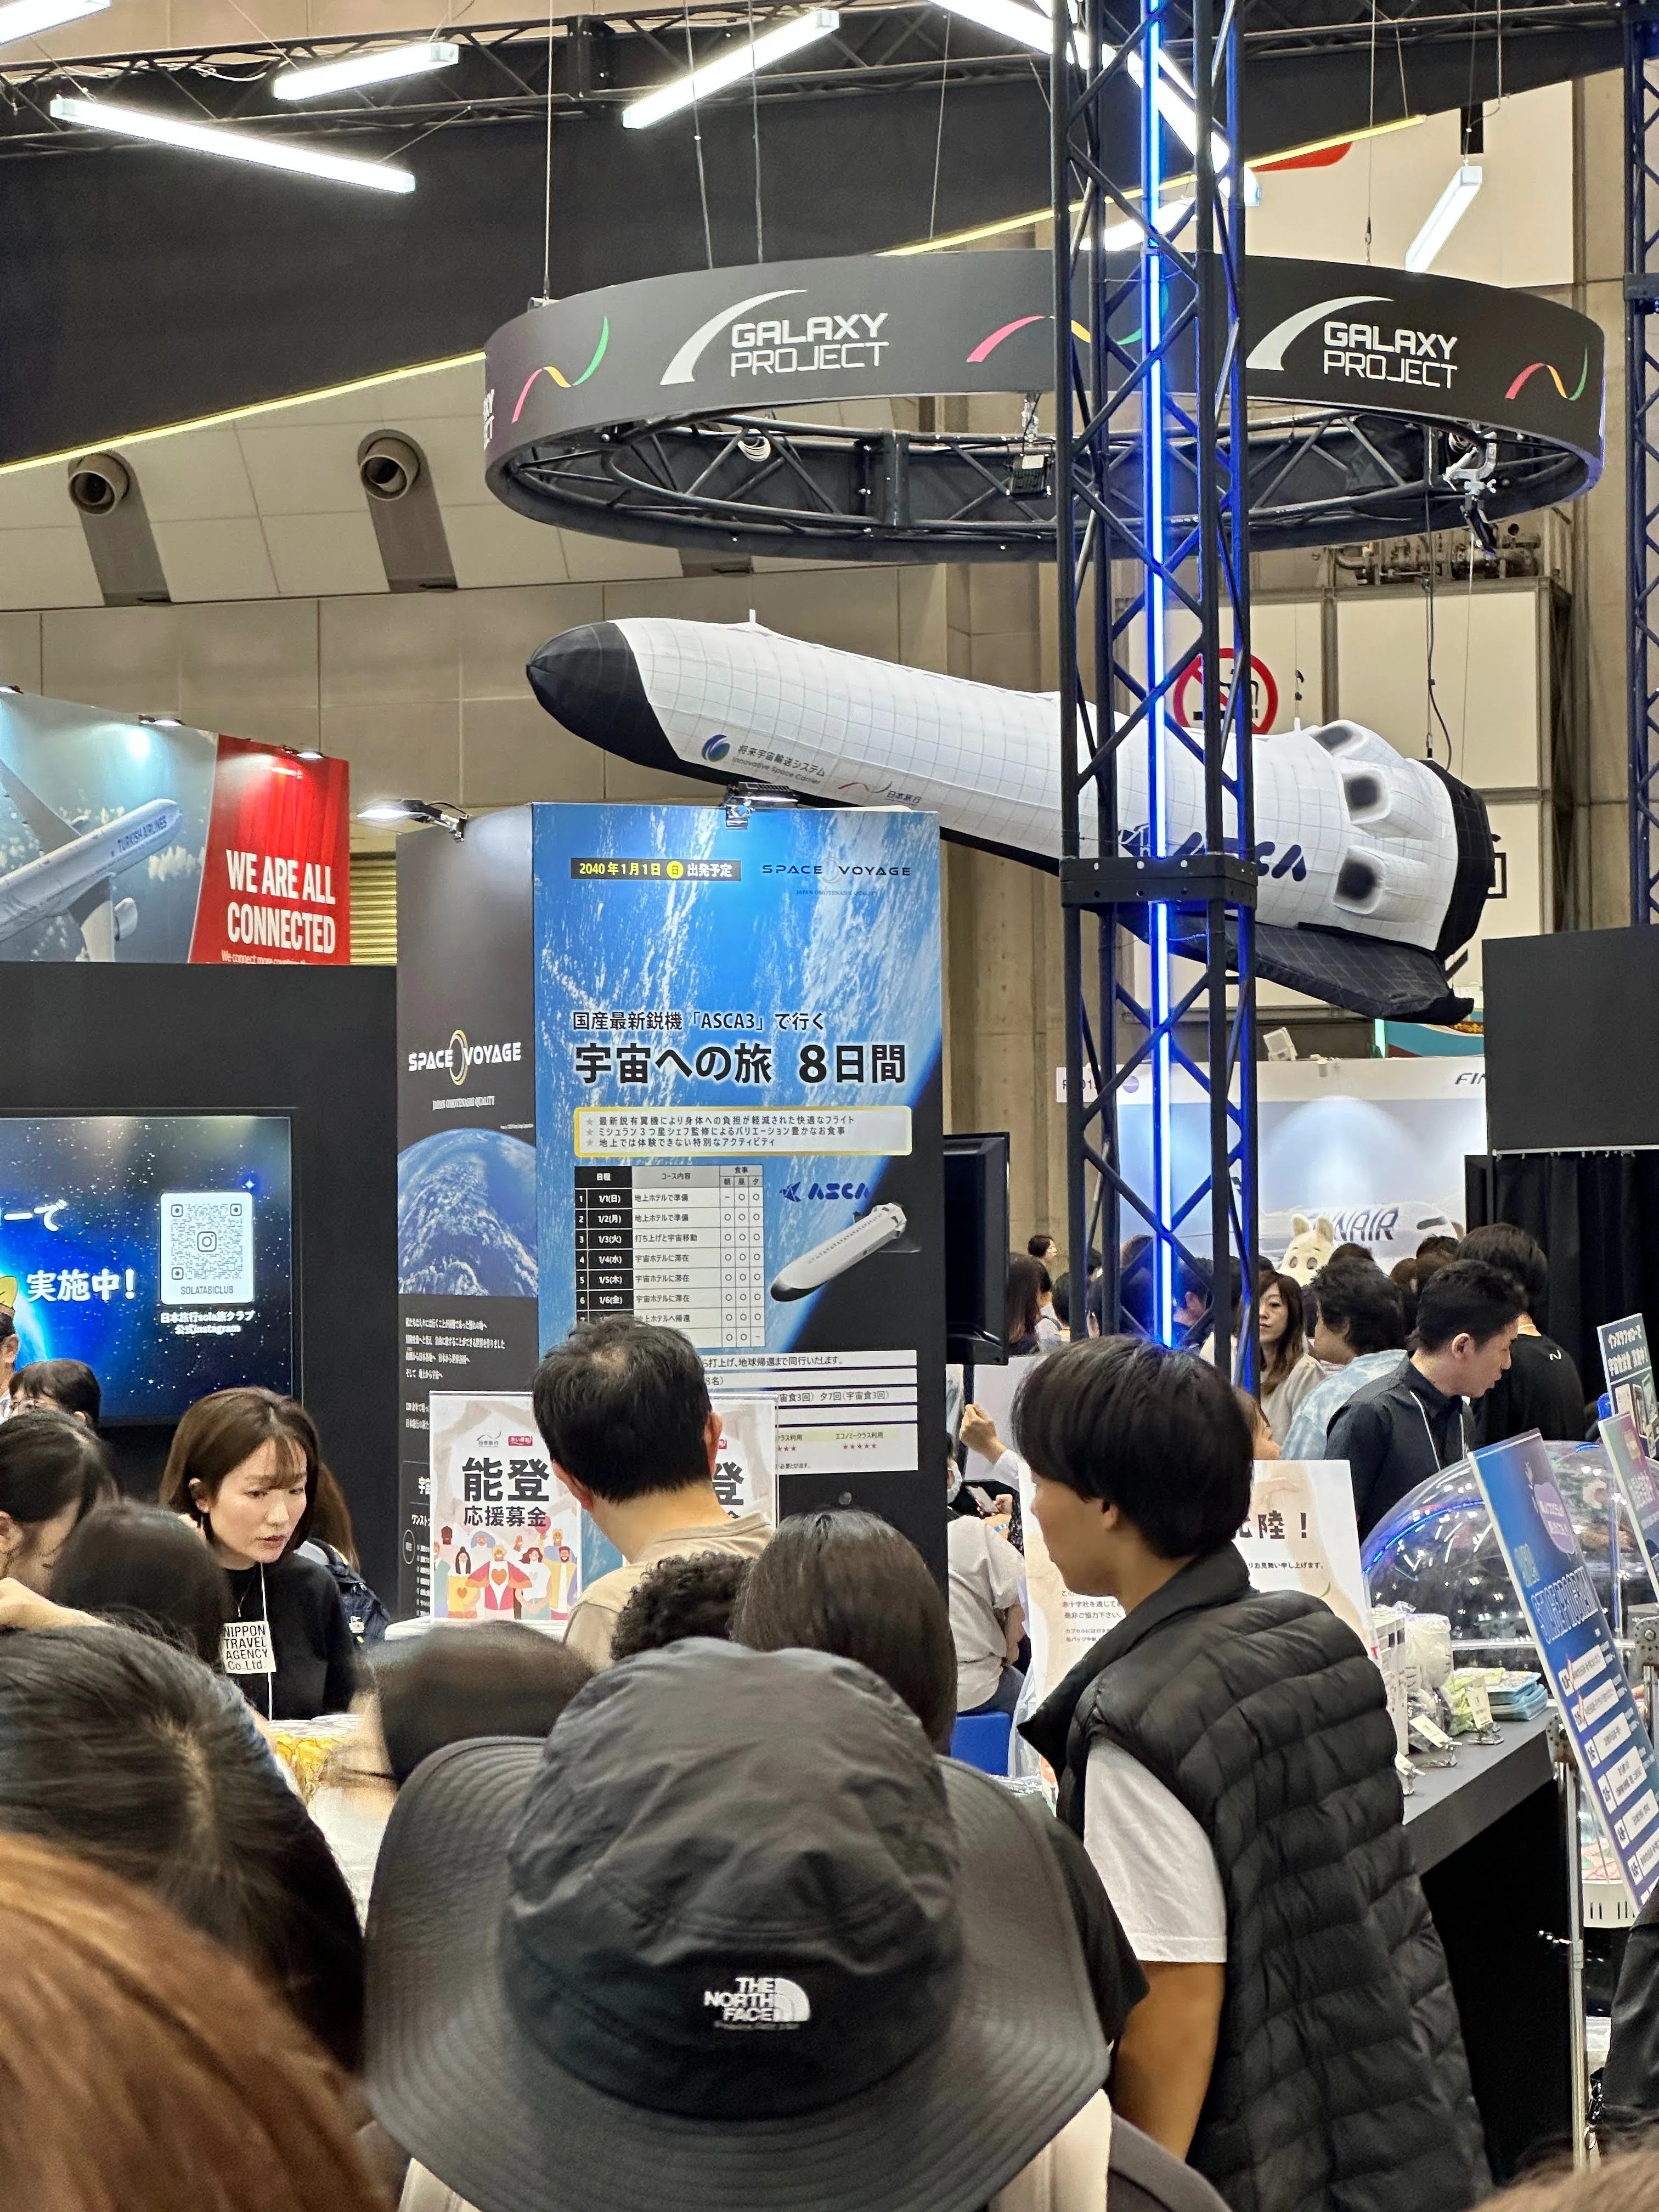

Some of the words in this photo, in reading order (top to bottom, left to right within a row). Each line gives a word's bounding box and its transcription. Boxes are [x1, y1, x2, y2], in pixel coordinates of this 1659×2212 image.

[732, 313, 888, 348] GALAXY
[1324, 320, 1457, 360] GALAXY
[731, 342, 889, 377] PROJECT
[1324, 350, 1458, 389] PROJECT
[738, 744, 825, 777] 将来宇宙輸送システム
[887, 791, 922, 804] 日本旅行
[226, 849, 258, 893] WE
[262, 855, 299, 899] ARE
[302, 863, 336, 905] ALL
[687, 862, 732, 878] 出発予定
[762, 865, 823, 874] SPACE
[838, 866, 911, 876] VOYAGE
[227, 902, 336, 955] CONNECTED
[573, 1011, 823, 1031] 国産最新鋭機「ASCA3」で行く
[408, 1049, 453, 1071] SPACE
[463, 1042, 521, 1066] VOYAGE
[575, 1042, 772, 1084] 宇宙への旅
[798, 1043, 906, 1084] 8日間
[634, 1194, 689, 1202] 地上ホテルで準備
[808, 1183, 870, 1200] ASCA
[635, 1214, 689, 1222] 地上ホテルで準備
[1332, 1207, 1400, 1242] NAIR
[635, 1254, 689, 1262] 宇宙ホテルに滞在
[26, 1268, 136, 1302] 実施中!
[635, 1274, 690, 1283] 宇宙ホテルに滞在
[180, 1285, 234, 1295] SOLATABICLUB
[636, 1295, 690, 1303] 宇宙ホテルに滞在
[462, 1457, 549, 1502] 能登
[463, 1505, 547, 1527] 応援募金
[224, 1625, 266, 1638] NIPPON
[224, 1637, 267, 1649] TRAVEL
[226, 1648, 267, 1660] AGENCY
[735, 1978, 775, 1993] THE
[704, 1991, 775, 2008] NORTH
[723, 2007, 774, 2022] FACE
